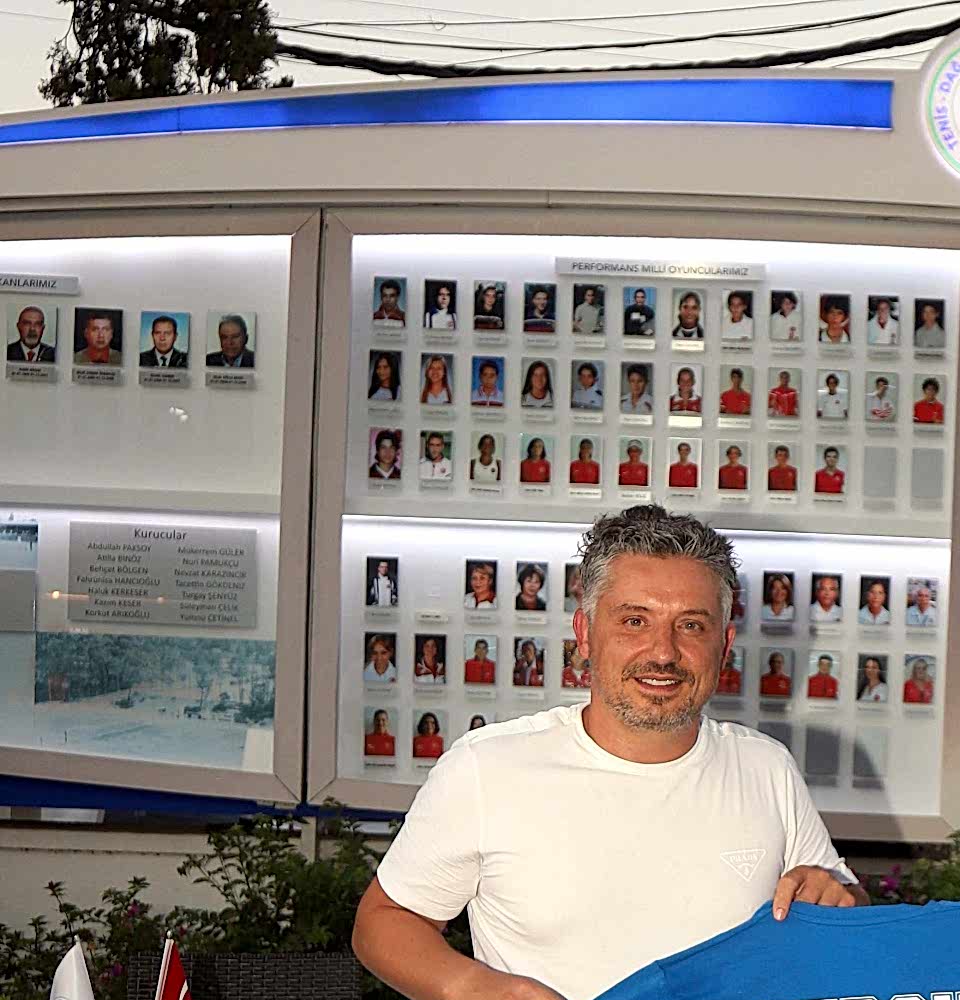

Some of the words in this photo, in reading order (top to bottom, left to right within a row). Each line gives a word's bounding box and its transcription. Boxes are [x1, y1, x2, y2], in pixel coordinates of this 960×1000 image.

[572, 261, 640, 273] PERFORMANS
[668, 264, 749, 277] OYUNCULARIMIZ
[134, 528, 188, 540] Kurucular
[87, 542, 121, 551] Abdullah
